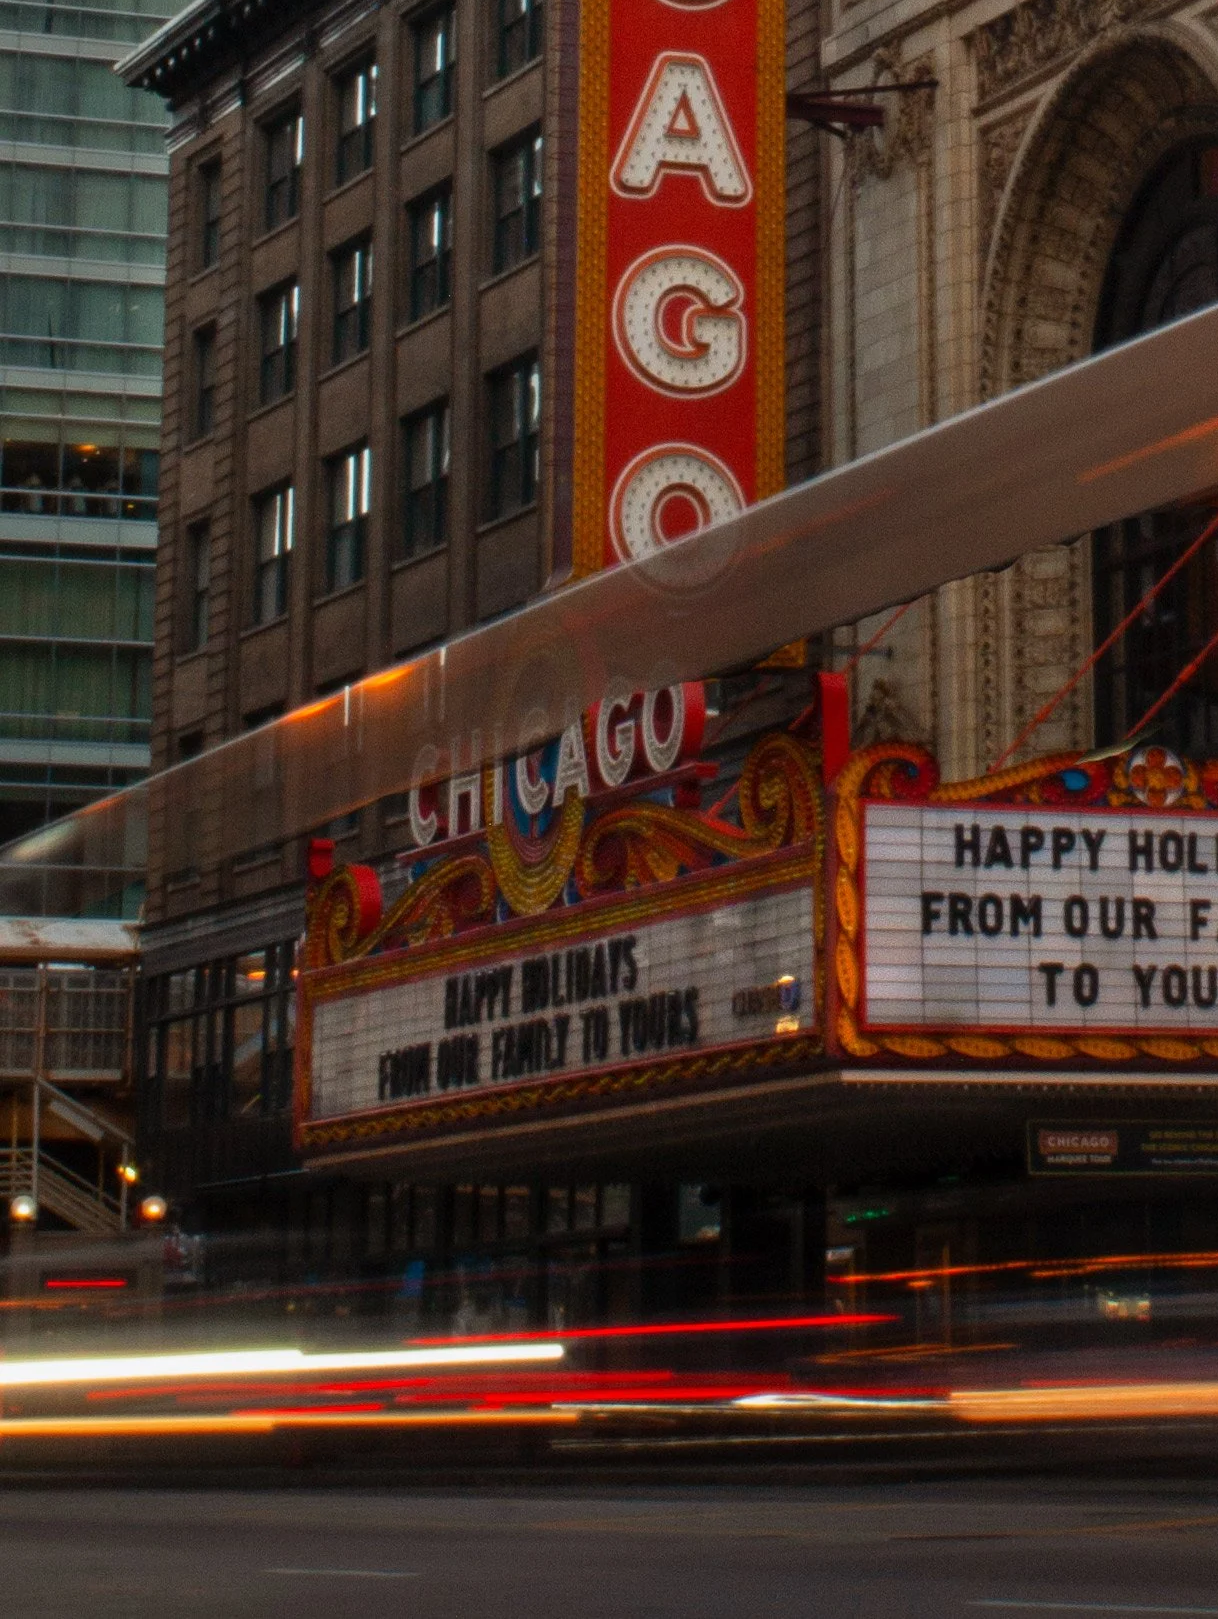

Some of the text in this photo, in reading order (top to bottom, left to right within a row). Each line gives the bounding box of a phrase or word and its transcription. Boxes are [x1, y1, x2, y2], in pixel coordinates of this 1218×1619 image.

[408, 680, 685, 847] CHICAGO
[955, 824, 1105, 871] HAPPY
[921, 892, 1042, 938] FROM
[1065, 895, 1157, 941] OUR
[444, 934, 638, 1029] HAPPY HOLIDAYS
[1039, 962, 1099, 1007] TO
[378, 1042, 431, 1101] FROM
[437, 1033, 479, 1090] OUR
[492, 1014, 570, 1081] FAMILY
[580, 1005, 609, 1064] TO
[618, 987, 698, 1056] YOURS
[1047, 1135, 1110, 1148] CHICAGO
